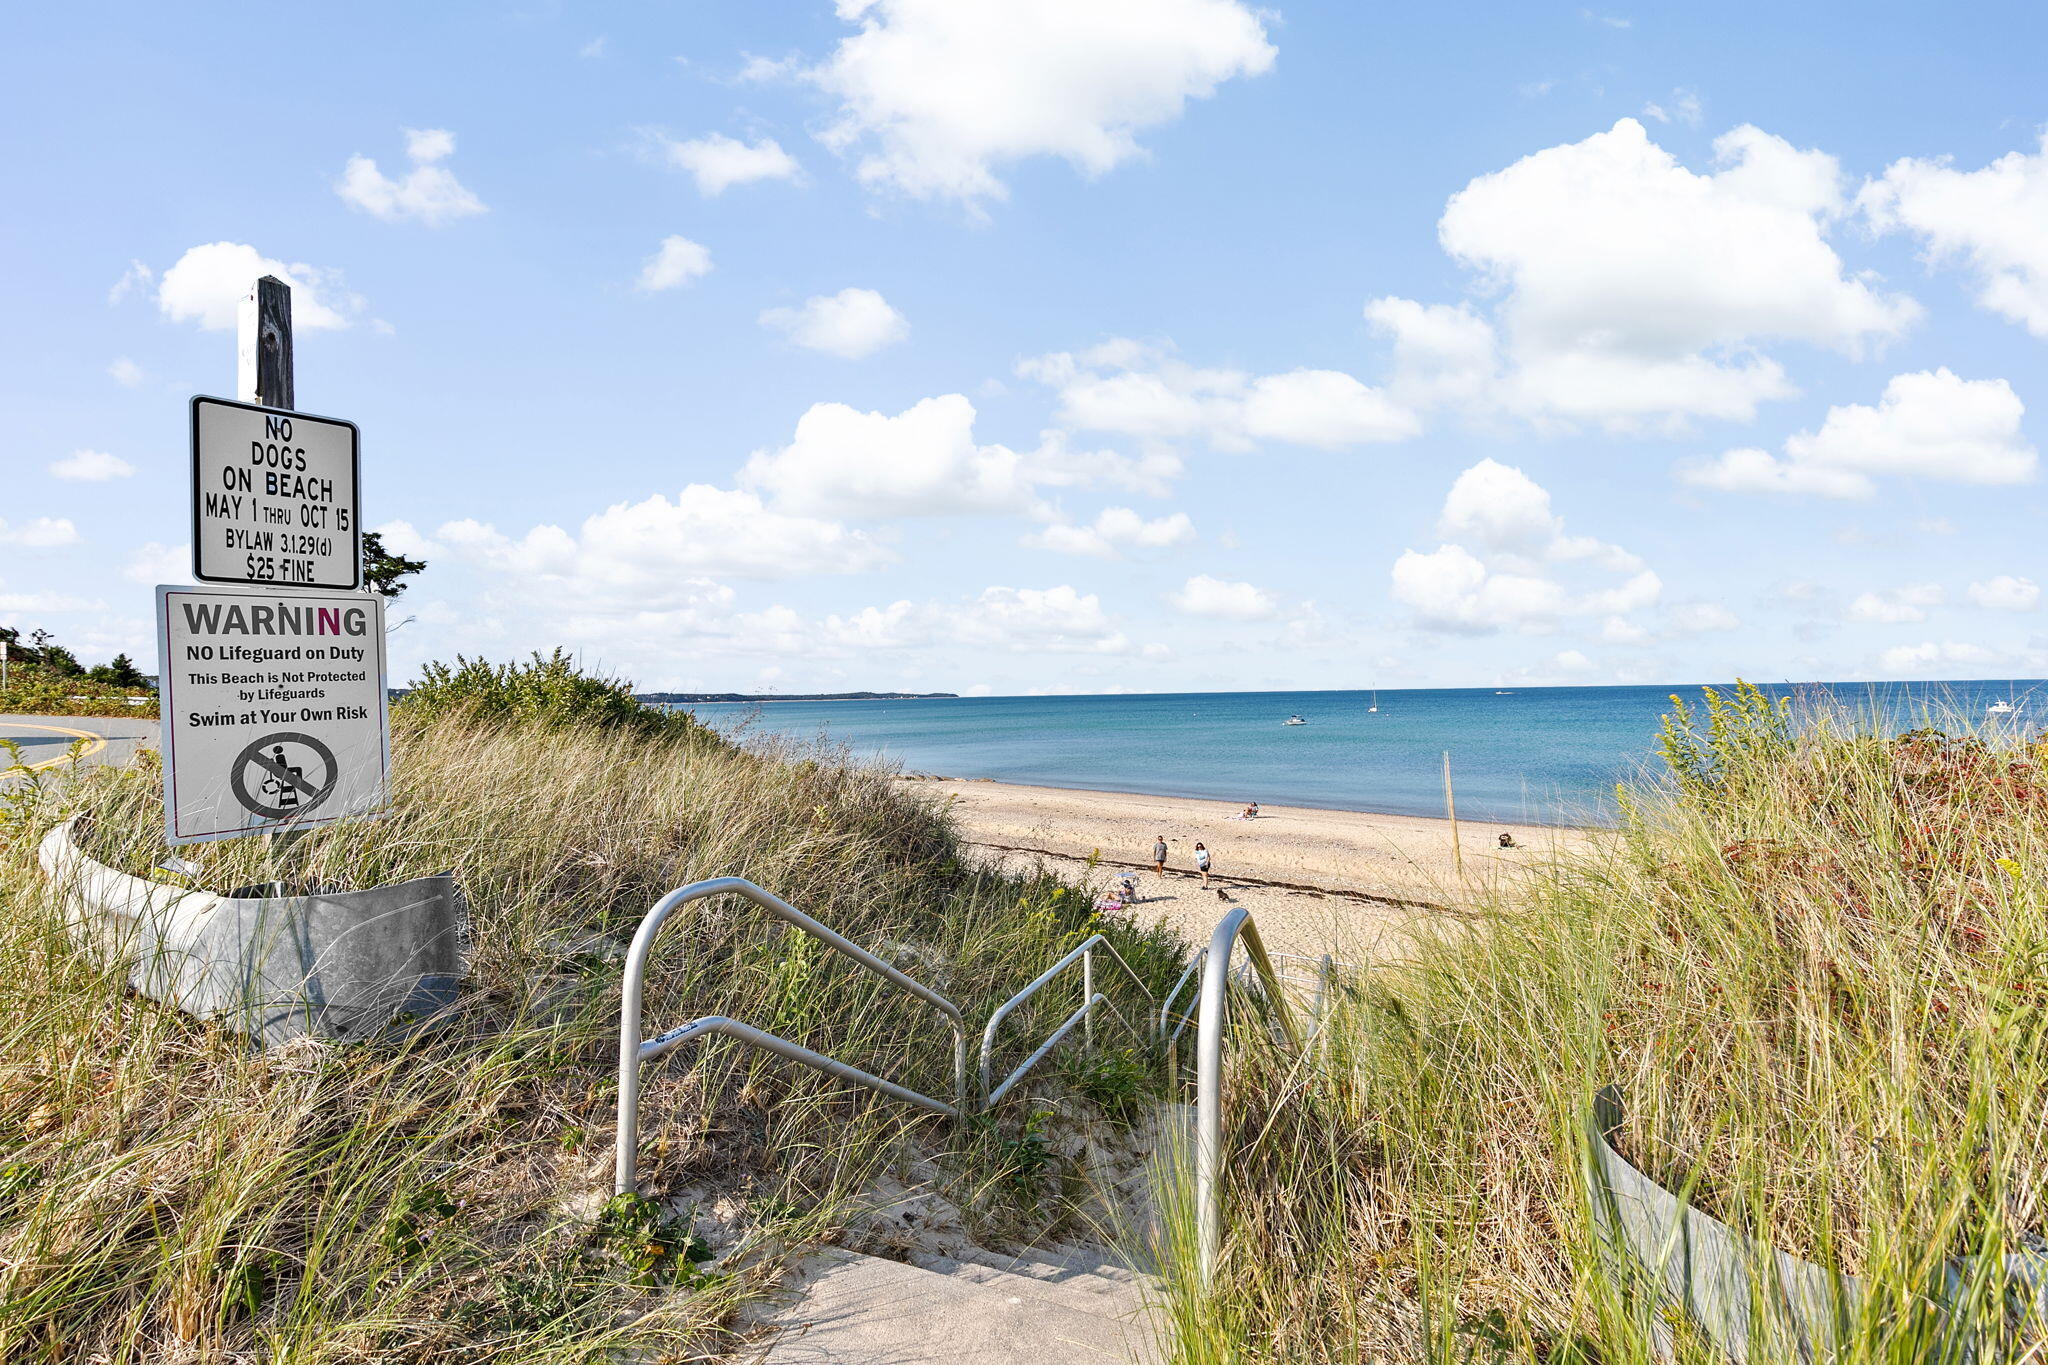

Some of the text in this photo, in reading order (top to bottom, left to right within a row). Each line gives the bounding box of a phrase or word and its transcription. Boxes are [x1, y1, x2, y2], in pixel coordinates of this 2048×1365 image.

[266, 416, 292, 442] NO
[252, 441, 306, 471] DOGS
[223, 466, 332, 502] ON BEACH
[206, 492, 348, 531] MAY 1 THRU OCT 15
[226, 529, 332, 556] BYLAW 3.1.29(d)
[247, 553, 314, 582] $25 FINE
[182, 603, 366, 636] WARNING
[187, 646, 364, 662] NO Lifeguard on Duty
[189, 671, 365, 684] This Beach is Not Protected
[240, 688, 325, 702] by Lifeguards
[189, 706, 367, 727] Swim at Your Own Risk
